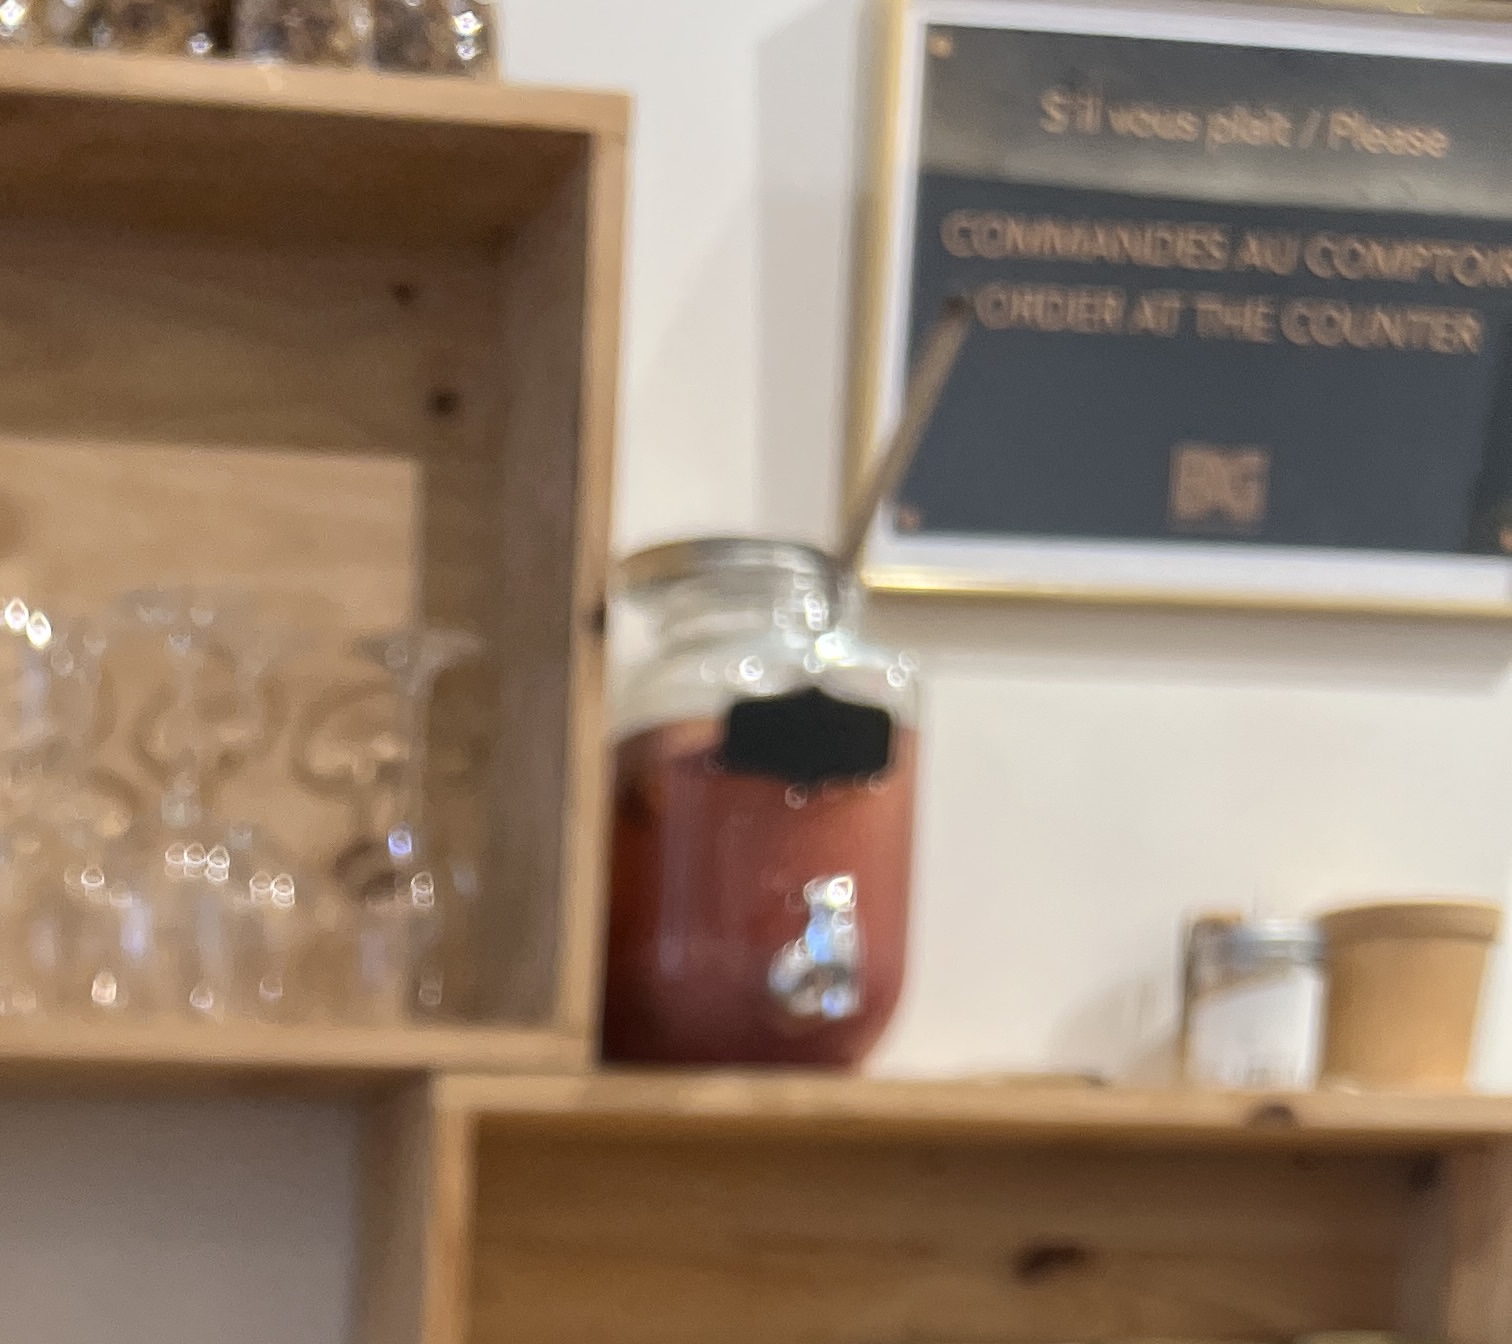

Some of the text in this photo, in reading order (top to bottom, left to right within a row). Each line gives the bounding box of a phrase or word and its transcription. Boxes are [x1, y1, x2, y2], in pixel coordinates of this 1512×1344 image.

[1108, 104, 1200, 142] vous
[1326, 104, 1451, 158] Please
[940, 210, 1229, 270] COMMANDES
[1235, 228, 1301, 277] AU
[974, 283, 1484, 354] ORDER AT THE COUNTER
